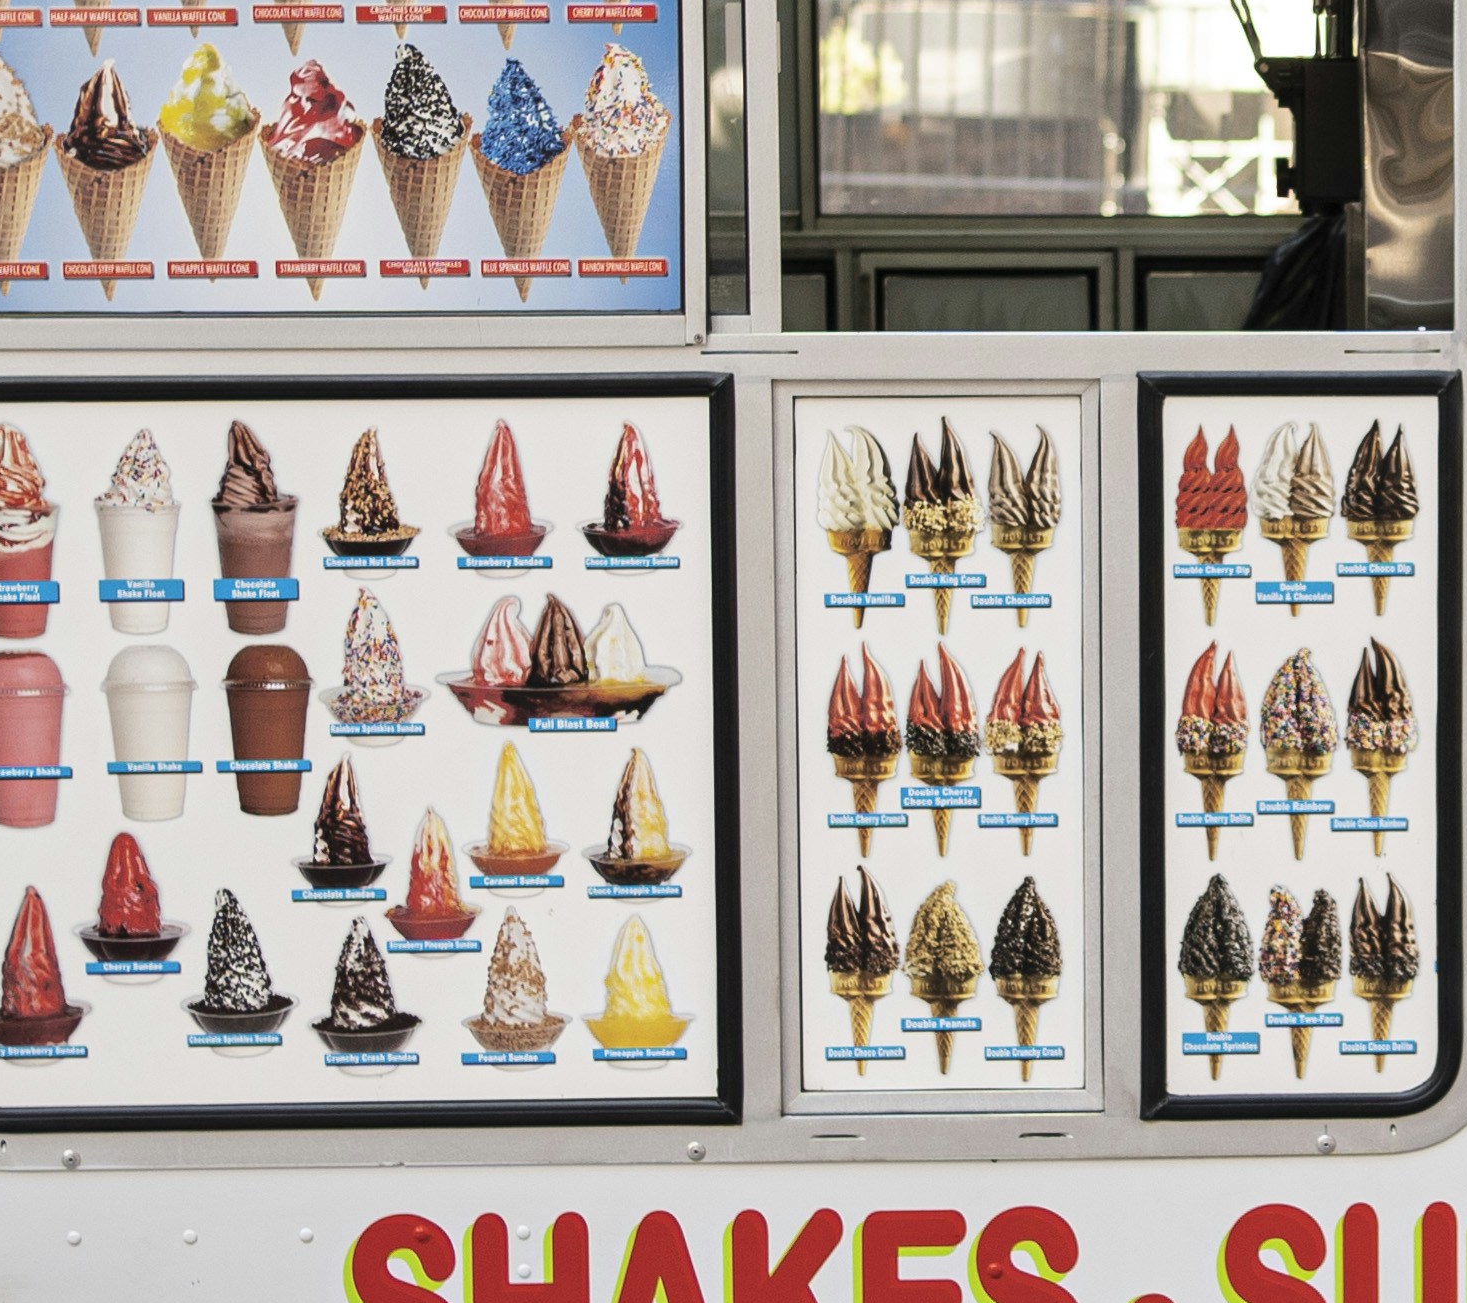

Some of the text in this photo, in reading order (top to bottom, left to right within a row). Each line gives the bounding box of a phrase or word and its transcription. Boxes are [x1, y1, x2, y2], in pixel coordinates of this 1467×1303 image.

[18, 12, 34, 23] CONE
[89, 12, 115, 22] WAFFLE
[116, 12, 137, 22] CONE
[153, 11, 226, 22] VANILLA WAFFLE CONE
[22, 265, 40, 276] CONE
[910, 575, 982, 586] Double King Cone
[831, 595, 896, 604] Double Vanilla
[973, 596, 1050, 605] Double Chocolate
[536, 719, 609, 728] Full Blast Boat
[127, 762, 183, 772] Vanilla Shake
[230, 761, 298, 771] Chocolate Shake
[35, 767, 61, 776] Shake
[1259, 801, 1332, 811] Double Rainbow
[484, 876, 550, 886] Caramel Sundae
[103, 963, 130, 972] Cherry
[906, 1019, 977, 1029] Double Peanuts
